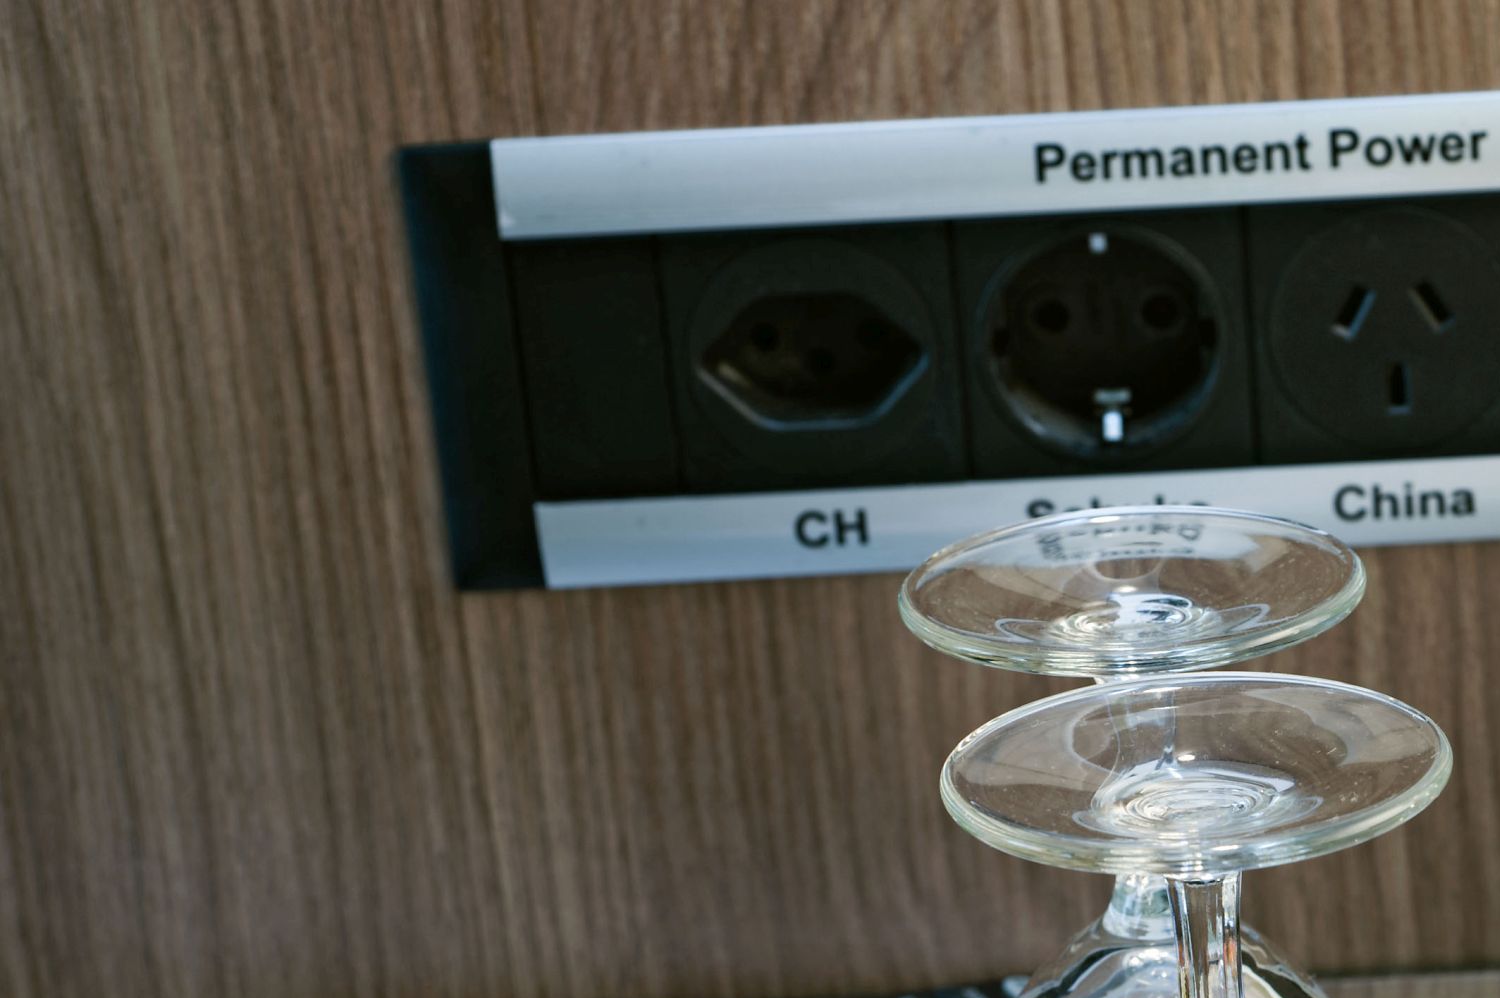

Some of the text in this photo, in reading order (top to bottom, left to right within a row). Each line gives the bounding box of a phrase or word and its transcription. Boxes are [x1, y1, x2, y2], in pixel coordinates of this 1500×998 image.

[1034, 127, 1488, 184] Permanent Power
[1332, 483, 1477, 522] China
[792, 507, 872, 550] CH
